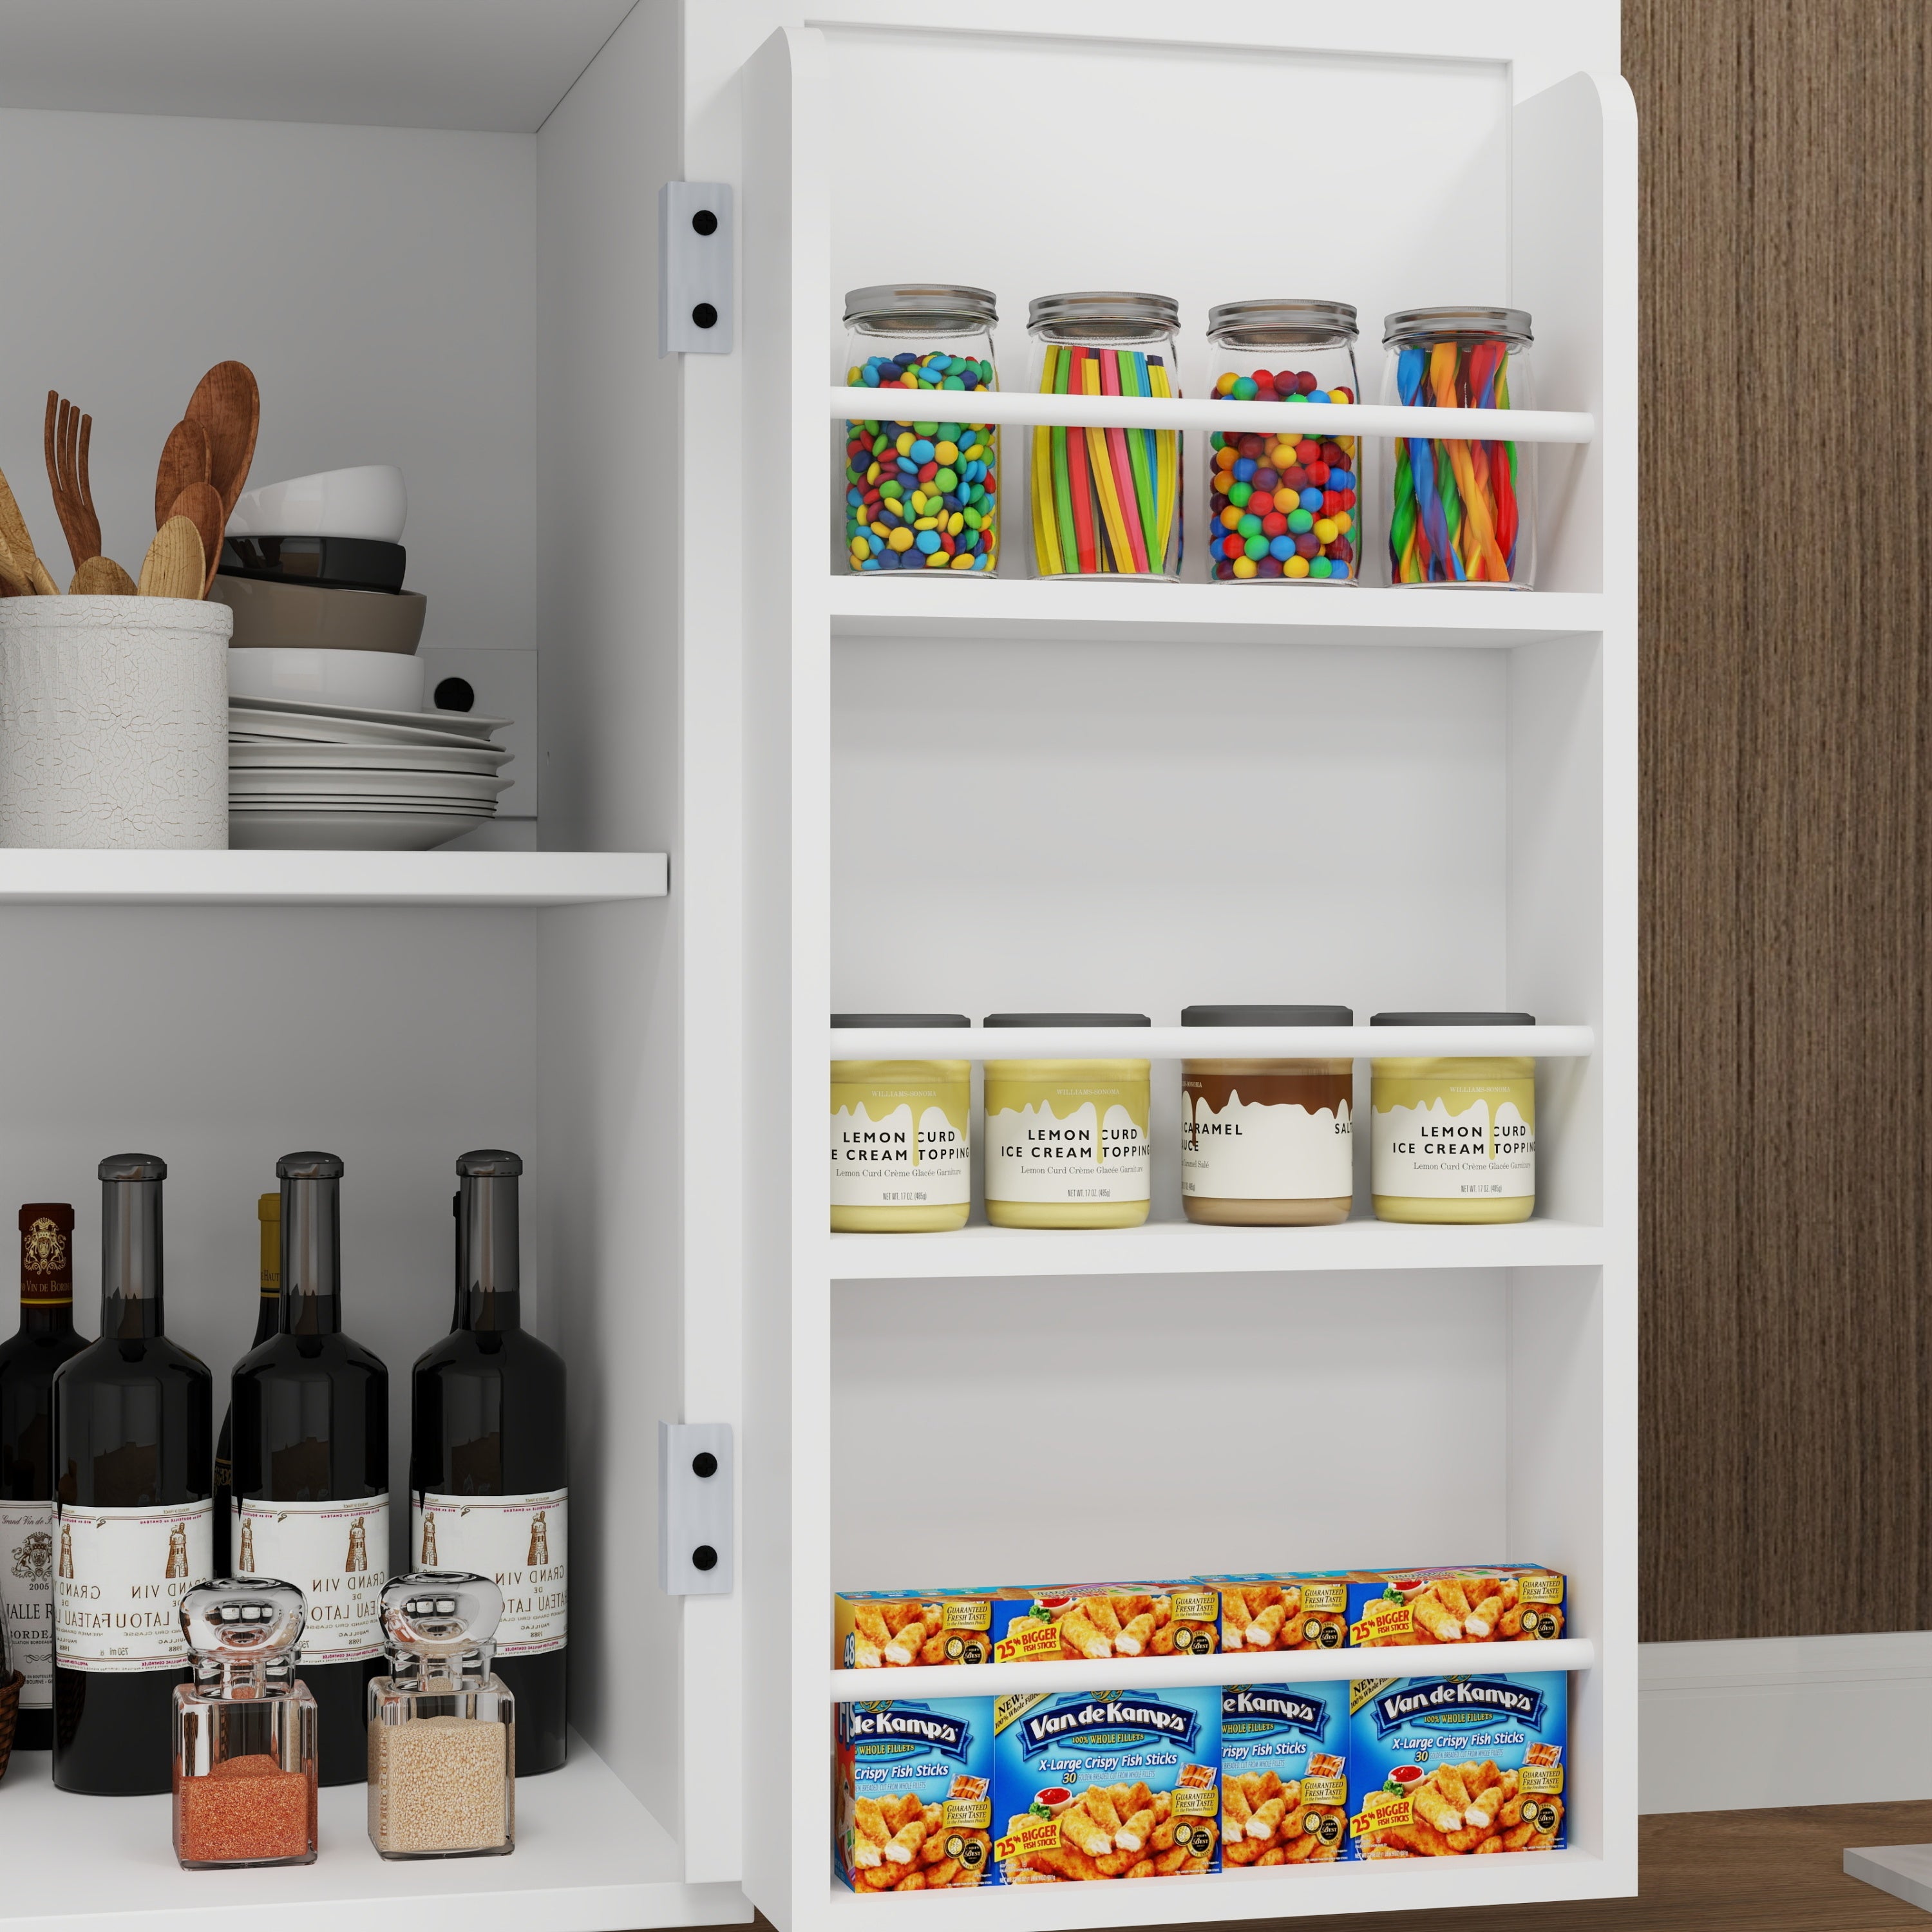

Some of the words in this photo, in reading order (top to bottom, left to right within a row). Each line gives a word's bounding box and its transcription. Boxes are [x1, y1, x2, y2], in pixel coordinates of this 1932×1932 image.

[1184, 1122, 1242, 1135] CARAMEL
[1421, 1126, 1482, 1137] LEMON
[1494, 1126, 1526, 1137] CURD
[844, 1132, 905, 1143] LEMON
[918, 1132, 955, 1142] CURD
[1028, 1130, 1090, 1141] LEMON
[1102, 1129, 1137, 1140] CURD
[846, 1150, 907, 1160] CREAM
[919, 1148, 969, 1160] TOPPING
[1001, 1146, 1023, 1157] ICE
[1032, 1147, 1092, 1158] CREAM
[1103, 1144, 1150, 1157] TOPPING
[1394, 1142, 1415, 1153] ICE
[1425, 1144, 1484, 1154] CREAM
[1021, 1166, 1045, 1174] Lemon
[1099, 1189, 1110, 1197] (485g)
[1491, 1184, 1502, 1193] (485g)
[1175, 1597, 1215, 1605] GUARANTEED
[947, 1605, 987, 1614] GUARANTEED
[1175, 1604, 1195, 1613] FRESH
[947, 1613, 967, 1622] FRESH
[1352, 1620, 1375, 1640] 25%
[1376, 1610, 1409, 1626] BIGGER
[1378, 1625, 1390, 1634] FISH
[1391, 1623, 1409, 1632] STICKS
[997, 1638, 1021, 1660] 25%
[1021, 1627, 1057, 1644] BIGGER
[1023, 1643, 1036, 1653] FISH
[1037, 1640, 1056, 1651] STICKS
[844, 1634, 855, 1666] 48
[1363, 1682, 1378, 1698] Whole
[1238, 1692, 1314, 1721] Kamp's
[1385, 1695, 1430, 1719] Van
[1430, 1685, 1456, 1703] de
[1457, 1683, 1531, 1712] Kamp's
[995, 1716, 1009, 1728] 100%
[1009, 1703, 1024, 1717] Whole
[1030, 1712, 1078, 1739] Van
[1078, 1706, 1104, 1724] de
[1107, 1702, 1184, 1731] Kamp's
[1424, 1715, 1439, 1723] 100%
[1441, 1714, 1466, 1723] WHOLE
[1467, 1713, 1493, 1721] FILLETS
[876, 1712, 956, 1741] Kamp's
[1222, 1723, 1246, 1734] WHOLE
[1248, 1723, 1274, 1732] FILLETS
[1072, 1736, 1088, 1744] 100%
[1090, 1734, 1115, 1744] WHOLE
[1117, 1733, 1144, 1742] FILLETS
[1392, 1737, 1433, 1752] X-Large
[1437, 1735, 1468, 1749] Crispy
[1471, 1733, 1491, 1746] Fish
[1494, 1732, 1524, 1745] Sticks
[859, 1745, 885, 1755] WHOLE
[887, 1744, 914, 1754] FILLETS
[1252, 1742, 1273, 1756] Fish
[1275, 1742, 1307, 1754] Sticks
[1039, 1758, 1082, 1772] X-Large
[1085, 1756, 1119, 1770] Crispy
[1121, 1754, 1143, 1767] Fish
[1146, 1752, 1177, 1765] Sticks
[1415, 1751, 1428, 1762] 30
[855, 1767, 889, 1782] Crispy
[891, 1765, 913, 1778] Fish
[916, 1763, 949, 1777] Sticks
[1063, 1772, 1076, 1784] 30
[1522, 1770, 1560, 1779] GUARANTEED
[1352, 1813, 1375, 1833] 25%
[1376, 1802, 1409, 1819] BIGGER
[1378, 1818, 1390, 1826] FISH
[1390, 1815, 1409, 1824] STICKS
[997, 1835, 1021, 1857] 25%
[1021, 1824, 1057, 1842] BIGGER
[1023, 1841, 1036, 1850] FISH
[1037, 1838, 1056, 1848] STICKS
